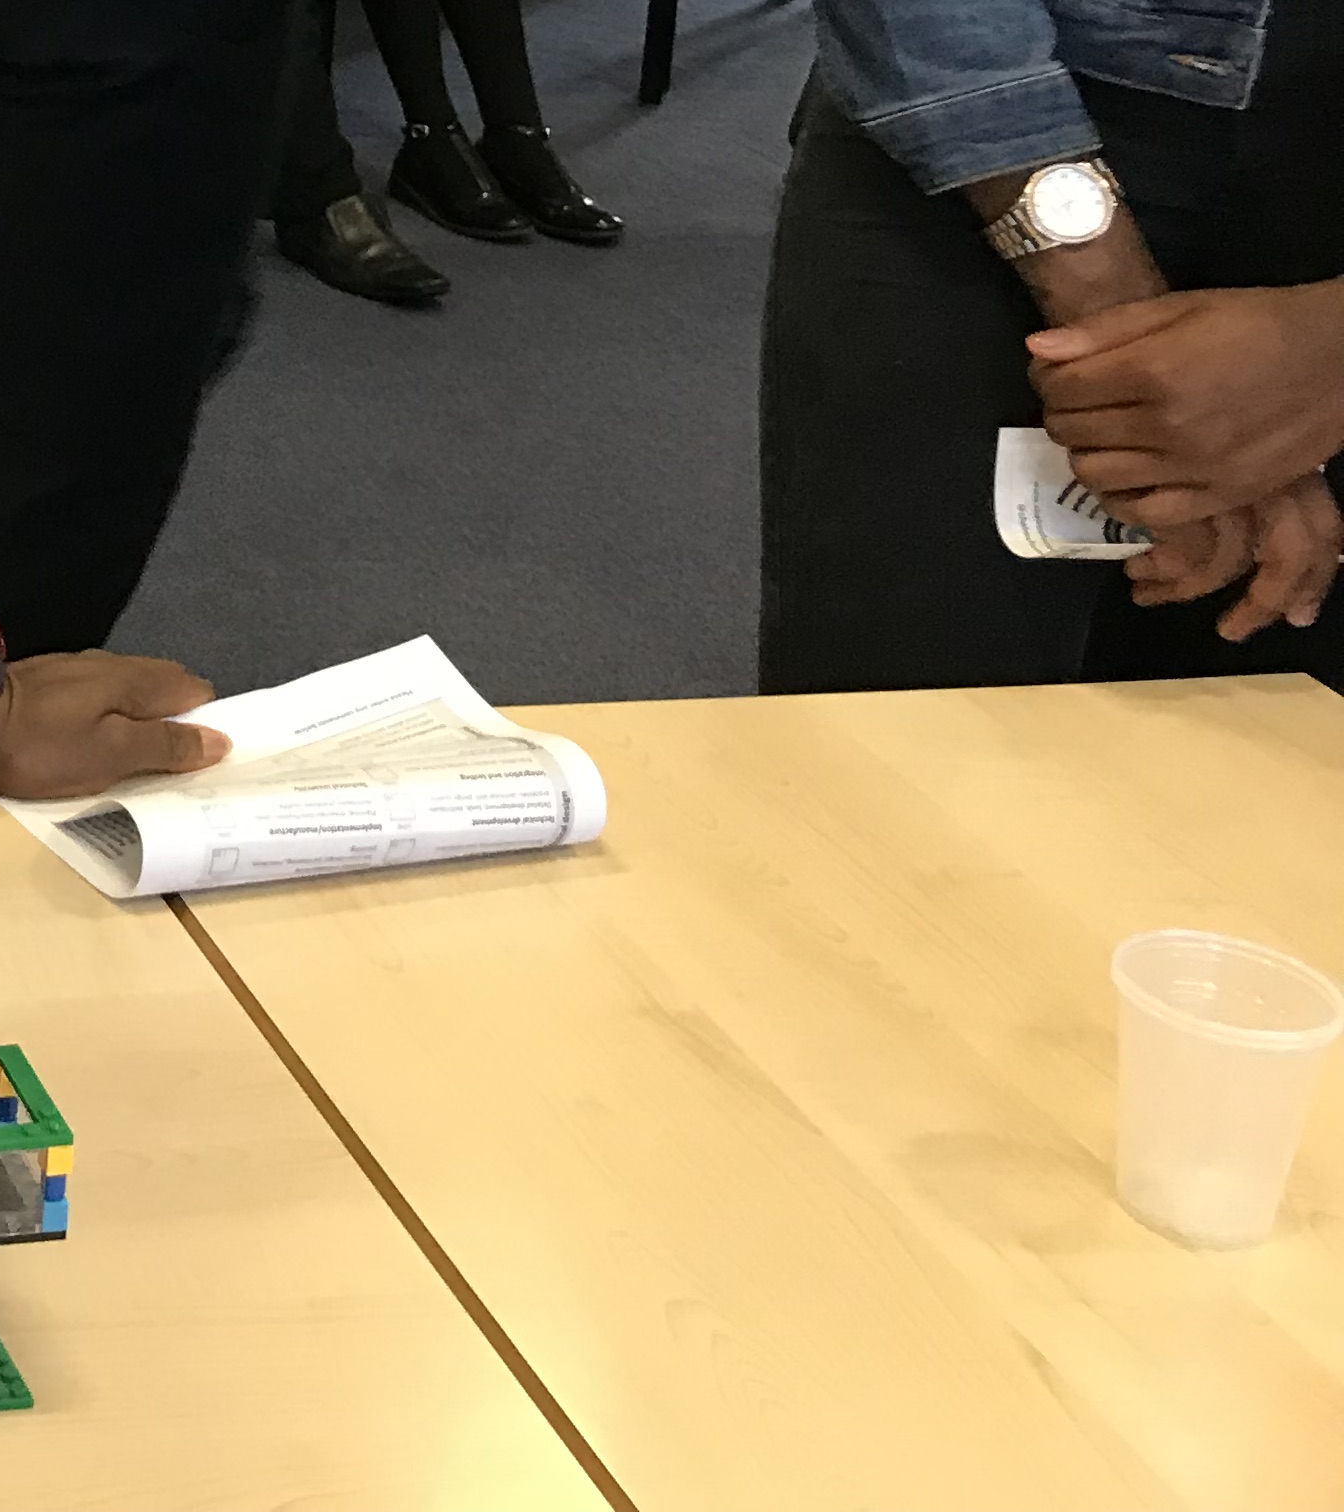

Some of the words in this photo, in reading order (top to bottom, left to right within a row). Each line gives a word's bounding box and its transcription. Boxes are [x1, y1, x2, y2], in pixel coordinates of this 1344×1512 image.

[472, 817, 521, 826] development
[523, 815, 555, 824] Technical
[269, 823, 382, 836] Implementation/manufacture
